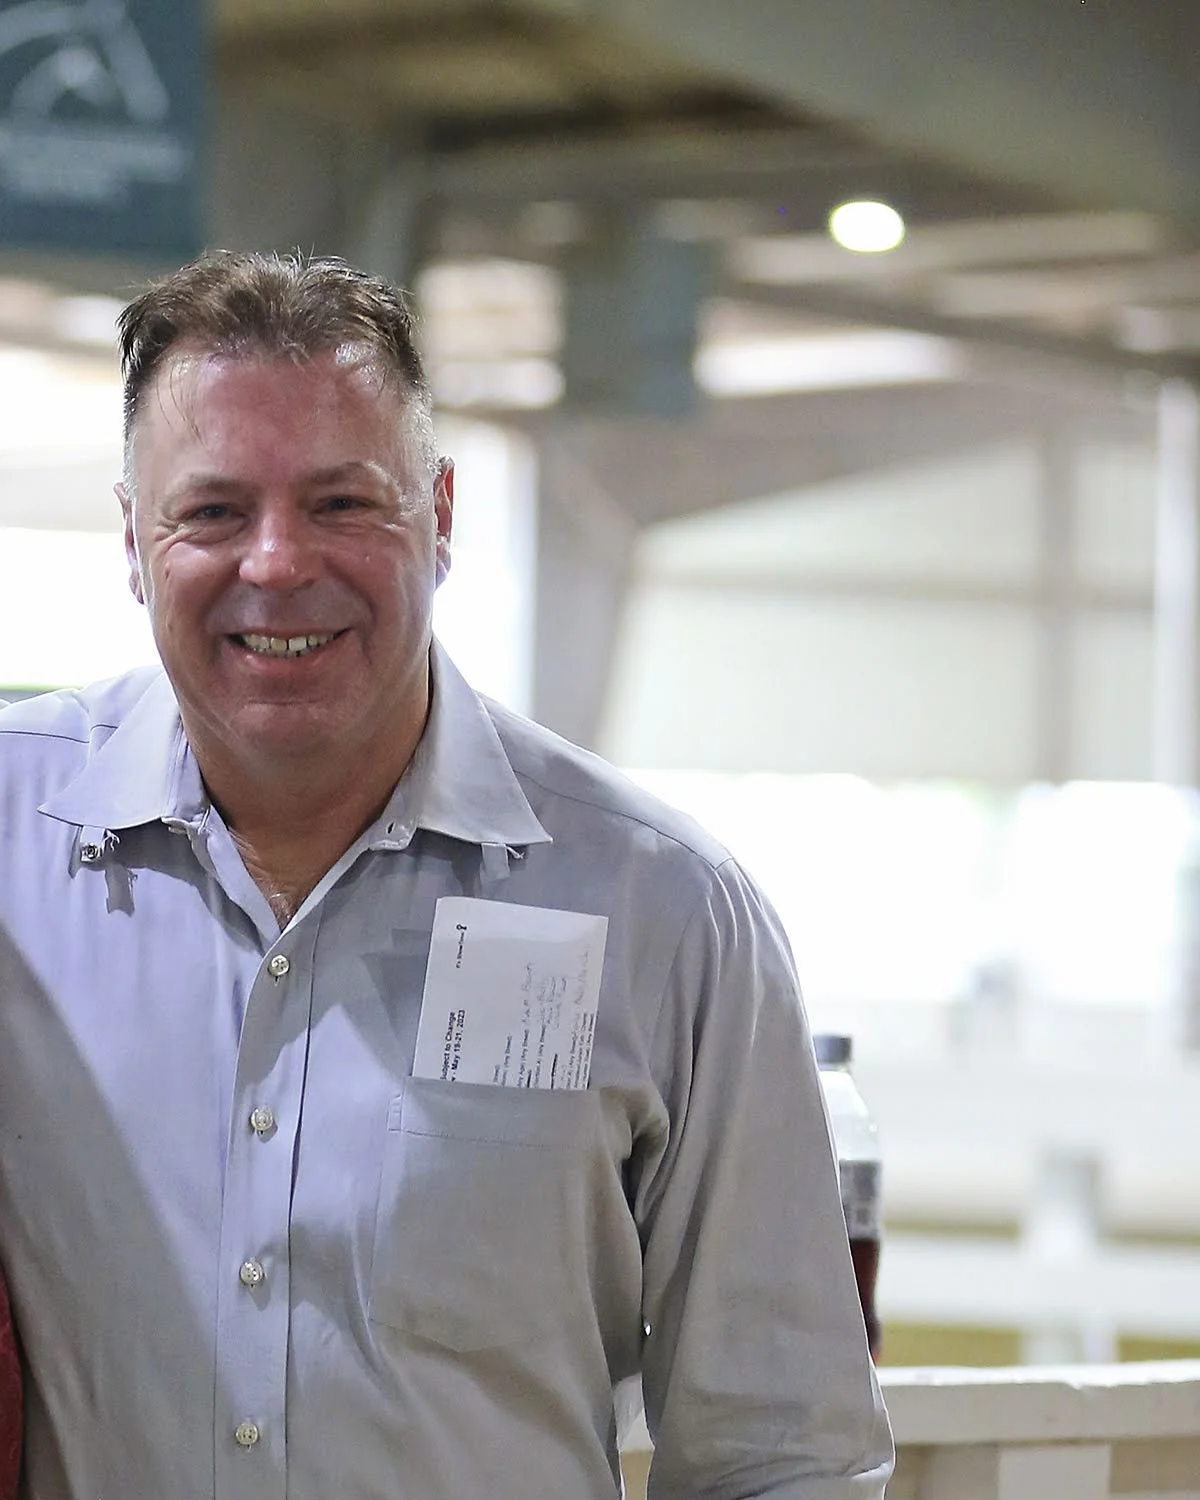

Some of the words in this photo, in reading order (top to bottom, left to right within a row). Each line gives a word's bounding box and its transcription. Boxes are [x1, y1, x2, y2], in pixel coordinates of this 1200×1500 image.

[445, 1011, 456, 1041] Change
[452, 1056, 460, 1070] May
[457, 1010, 465, 1029] 2023
[445, 1043, 451, 1052] to
